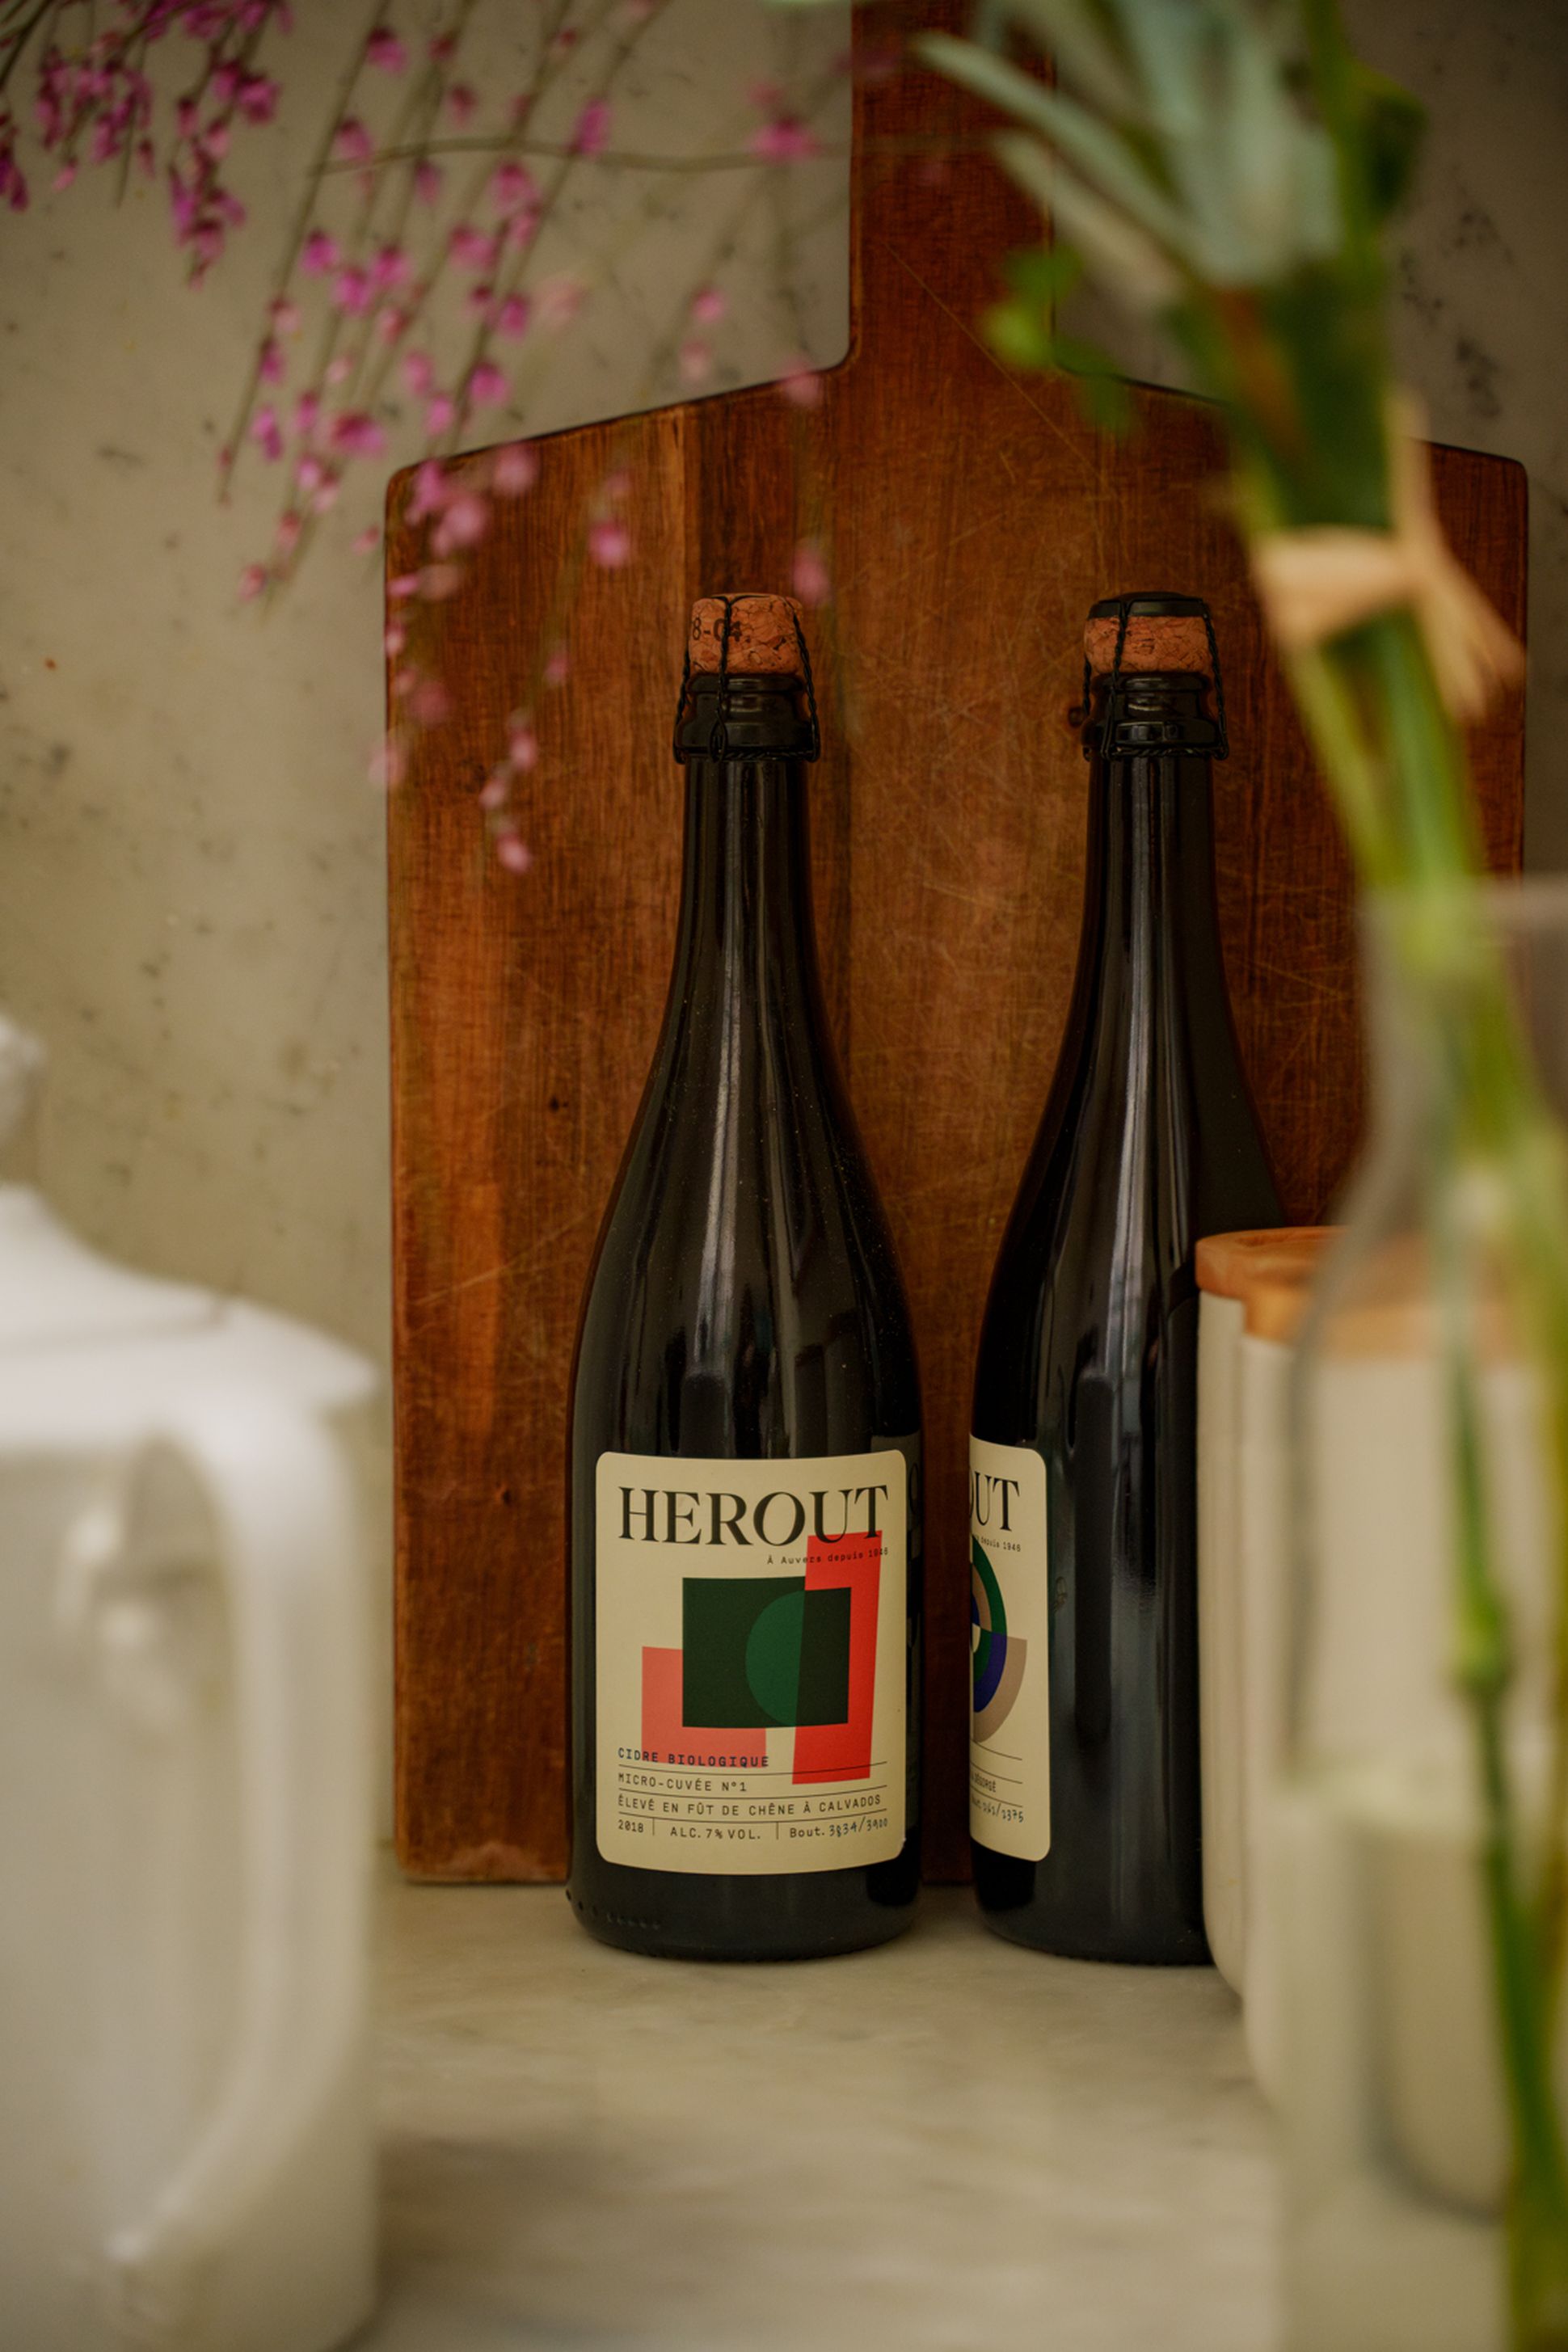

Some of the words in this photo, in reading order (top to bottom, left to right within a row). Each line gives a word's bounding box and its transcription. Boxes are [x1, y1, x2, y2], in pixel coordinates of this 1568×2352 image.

[970, 1471, 1020, 1532] UT
[618, 1485, 889, 1548] HEROUT
[781, 1556, 821, 1565] Auvers
[828, 1551, 863, 1562] depuis
[618, 1747, 659, 1763] CIDRE
[668, 1755, 769, 1768] BIOLOGIQUE
[618, 1772, 712, 1791] MICRO-CUVÉE
[721, 1781, 748, 1792] N°1
[618, 1794, 655, 1811] ÉLEVÉ
[663, 1802, 680, 1814] EN
[687, 1801, 714, 1816] FÛT
[722, 1804, 740, 1816] DE
[748, 1802, 795, 1816] CHÊNE
[803, 1800, 811, 1813] À
[819, 1794, 882, 1812] CALVADOS
[618, 1819, 645, 1833] 2018
[670, 1827, 701, 1839] ALC.
[727, 1827, 761, 1840] VOL.
[790, 1826, 825, 1839] Bout.
